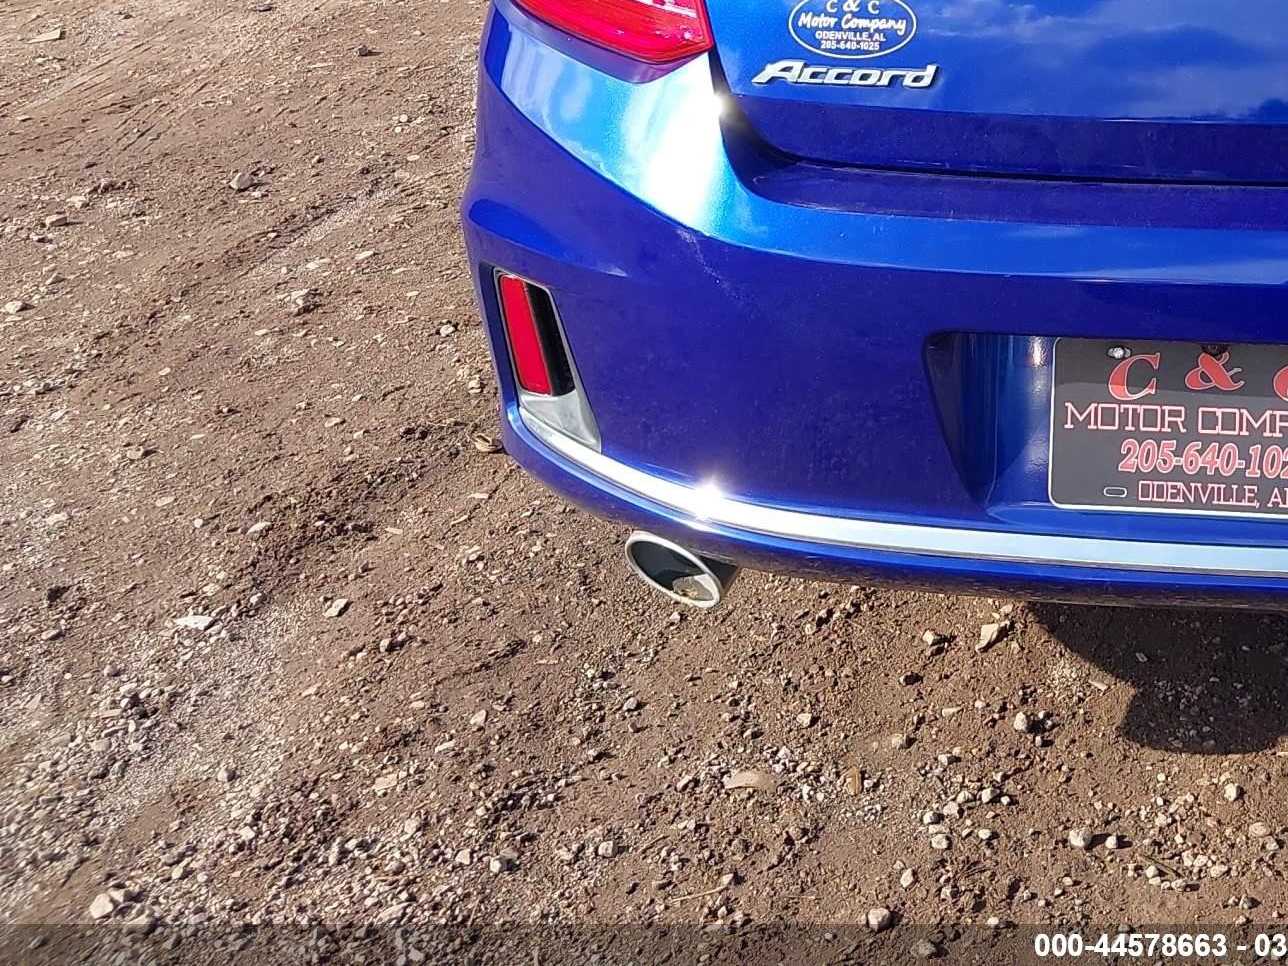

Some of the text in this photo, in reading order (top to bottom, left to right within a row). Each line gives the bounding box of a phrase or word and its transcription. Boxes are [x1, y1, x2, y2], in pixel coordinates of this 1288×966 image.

[826, 0, 838, 14] C
[868, 0, 880, 14] C
[798, 12, 907, 35] Motor Company
[815, 31, 886, 42] ODENVILLE, AL
[820, 41, 880, 50] 205-640-1025
[751, 59, 939, 87] Accord
[1108, 352, 1160, 400] C
[1184, 351, 1245, 391] &
[1064, 402, 1187, 433] MOTOR
[1138, 481, 1260, 508] ODENVILLE,
